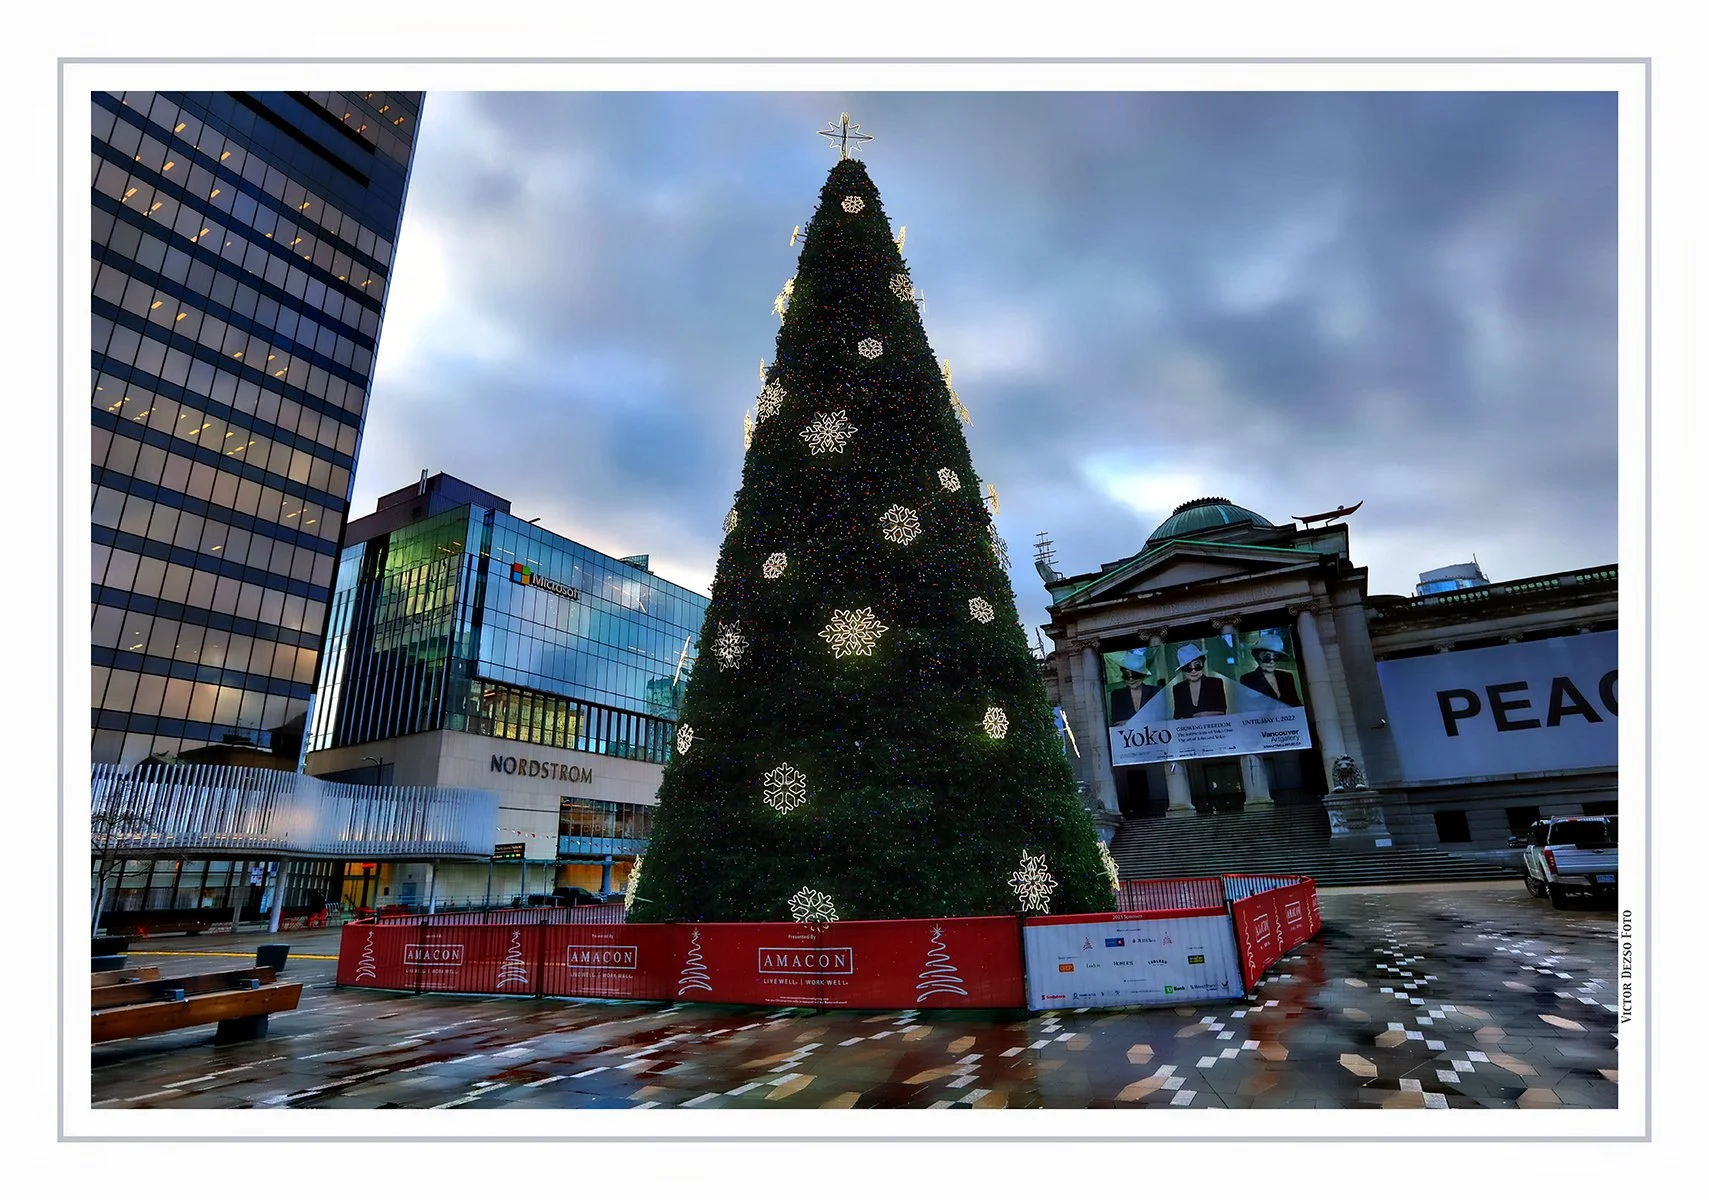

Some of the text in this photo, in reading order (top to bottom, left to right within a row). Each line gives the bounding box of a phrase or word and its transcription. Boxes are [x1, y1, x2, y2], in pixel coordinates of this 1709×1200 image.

[532, 574, 580, 600] Microsoft
[1176, 724, 1203, 732] GROWING
[1261, 729, 1299, 738] Vancouver
[1118, 726, 1172, 749] Yoko
[490, 754, 593, 784] NORDSTROM
[407, 949, 460, 960] AMACON
[571, 951, 633, 963] AMACON
[764, 954, 846, 967] AMACON
